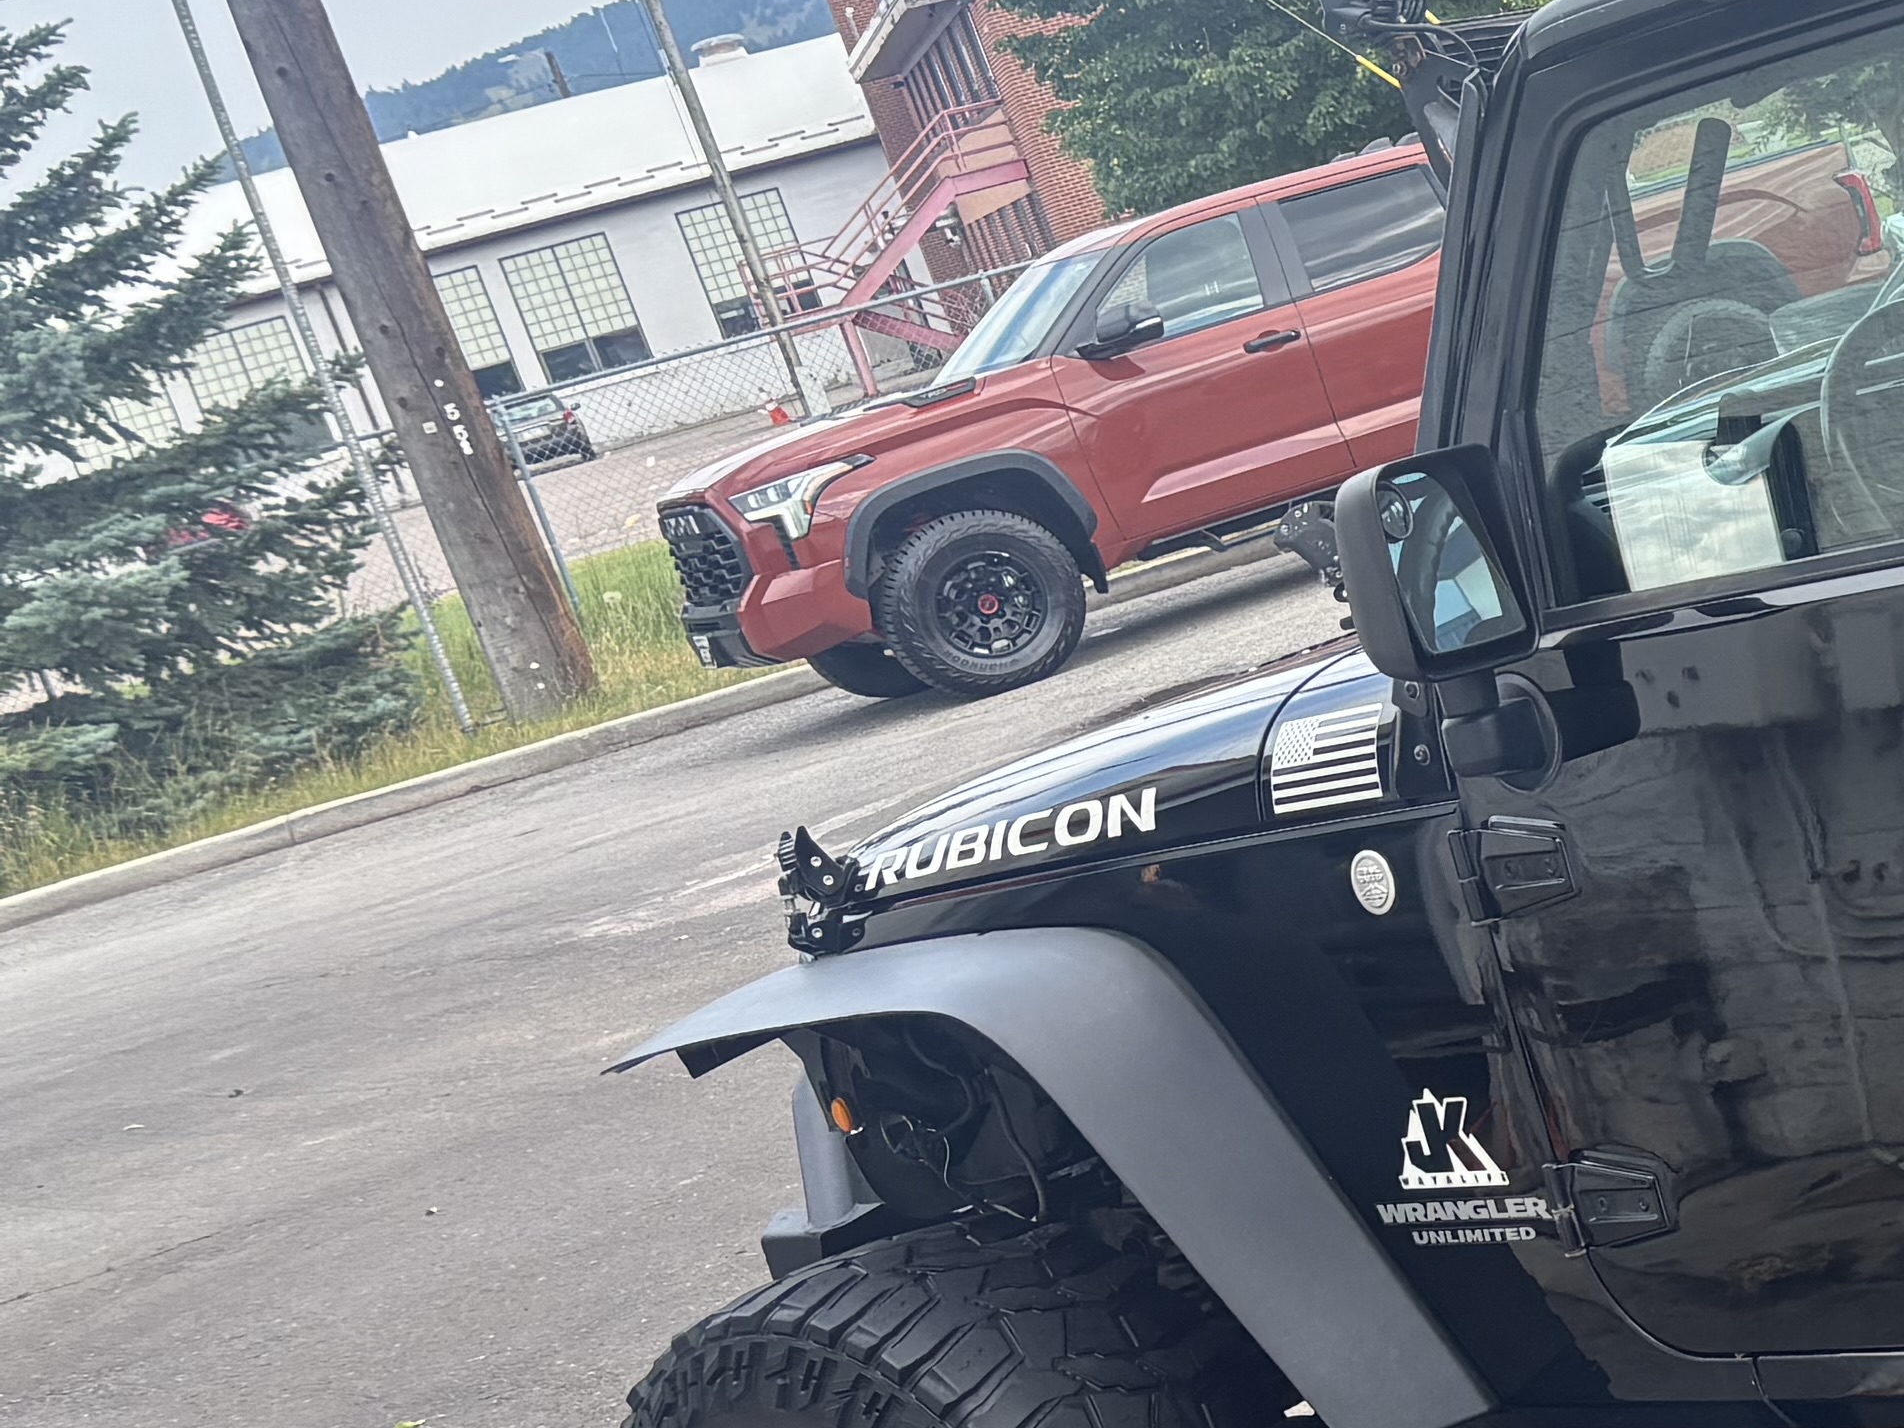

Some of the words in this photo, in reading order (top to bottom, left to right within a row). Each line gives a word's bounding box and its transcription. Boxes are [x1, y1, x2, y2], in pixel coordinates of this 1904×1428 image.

[864, 786, 1157, 892] RUBICON
[1376, 1197, 1552, 1224] WRANGLER
[1412, 1226, 1537, 1246] UNLIMITED
